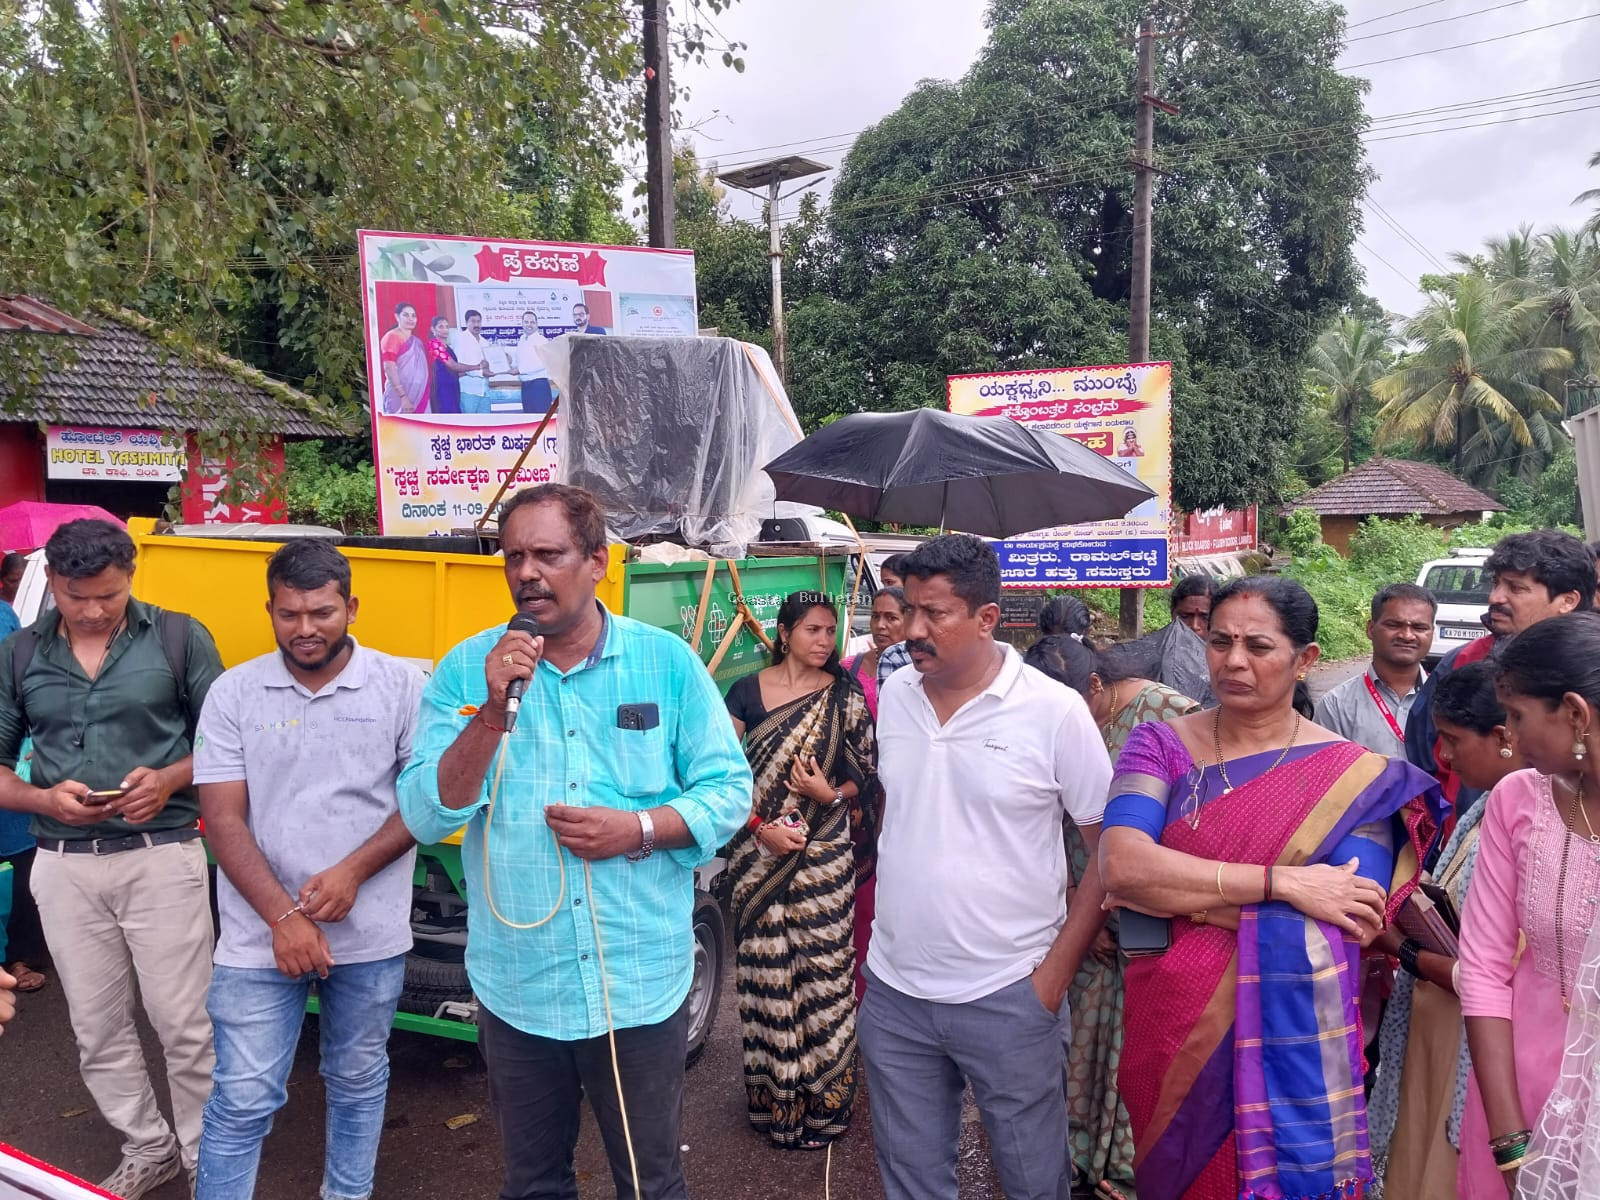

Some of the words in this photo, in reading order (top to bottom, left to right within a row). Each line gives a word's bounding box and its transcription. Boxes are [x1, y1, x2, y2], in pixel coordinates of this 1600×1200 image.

[502, 250, 580, 276] ಪ್ರಕಟಣೆ
[1073, 373, 1137, 395] ಮುಂಬೈ
[1072, 400, 1119, 416] ಸಂಭ್ರಮ
[456, 434, 496, 454] ಭಾರತ್
[51, 448, 104, 464] HOTEL
[108, 450, 187, 466] YASHMITH
[426, 464, 490, 493] ಸರ್ವೇಕ್ಷಣ
[402, 500, 447, 519] ದಿನಾಂಕ
[1085, 565, 1151, 580] ಸಮಸ್ತರು
